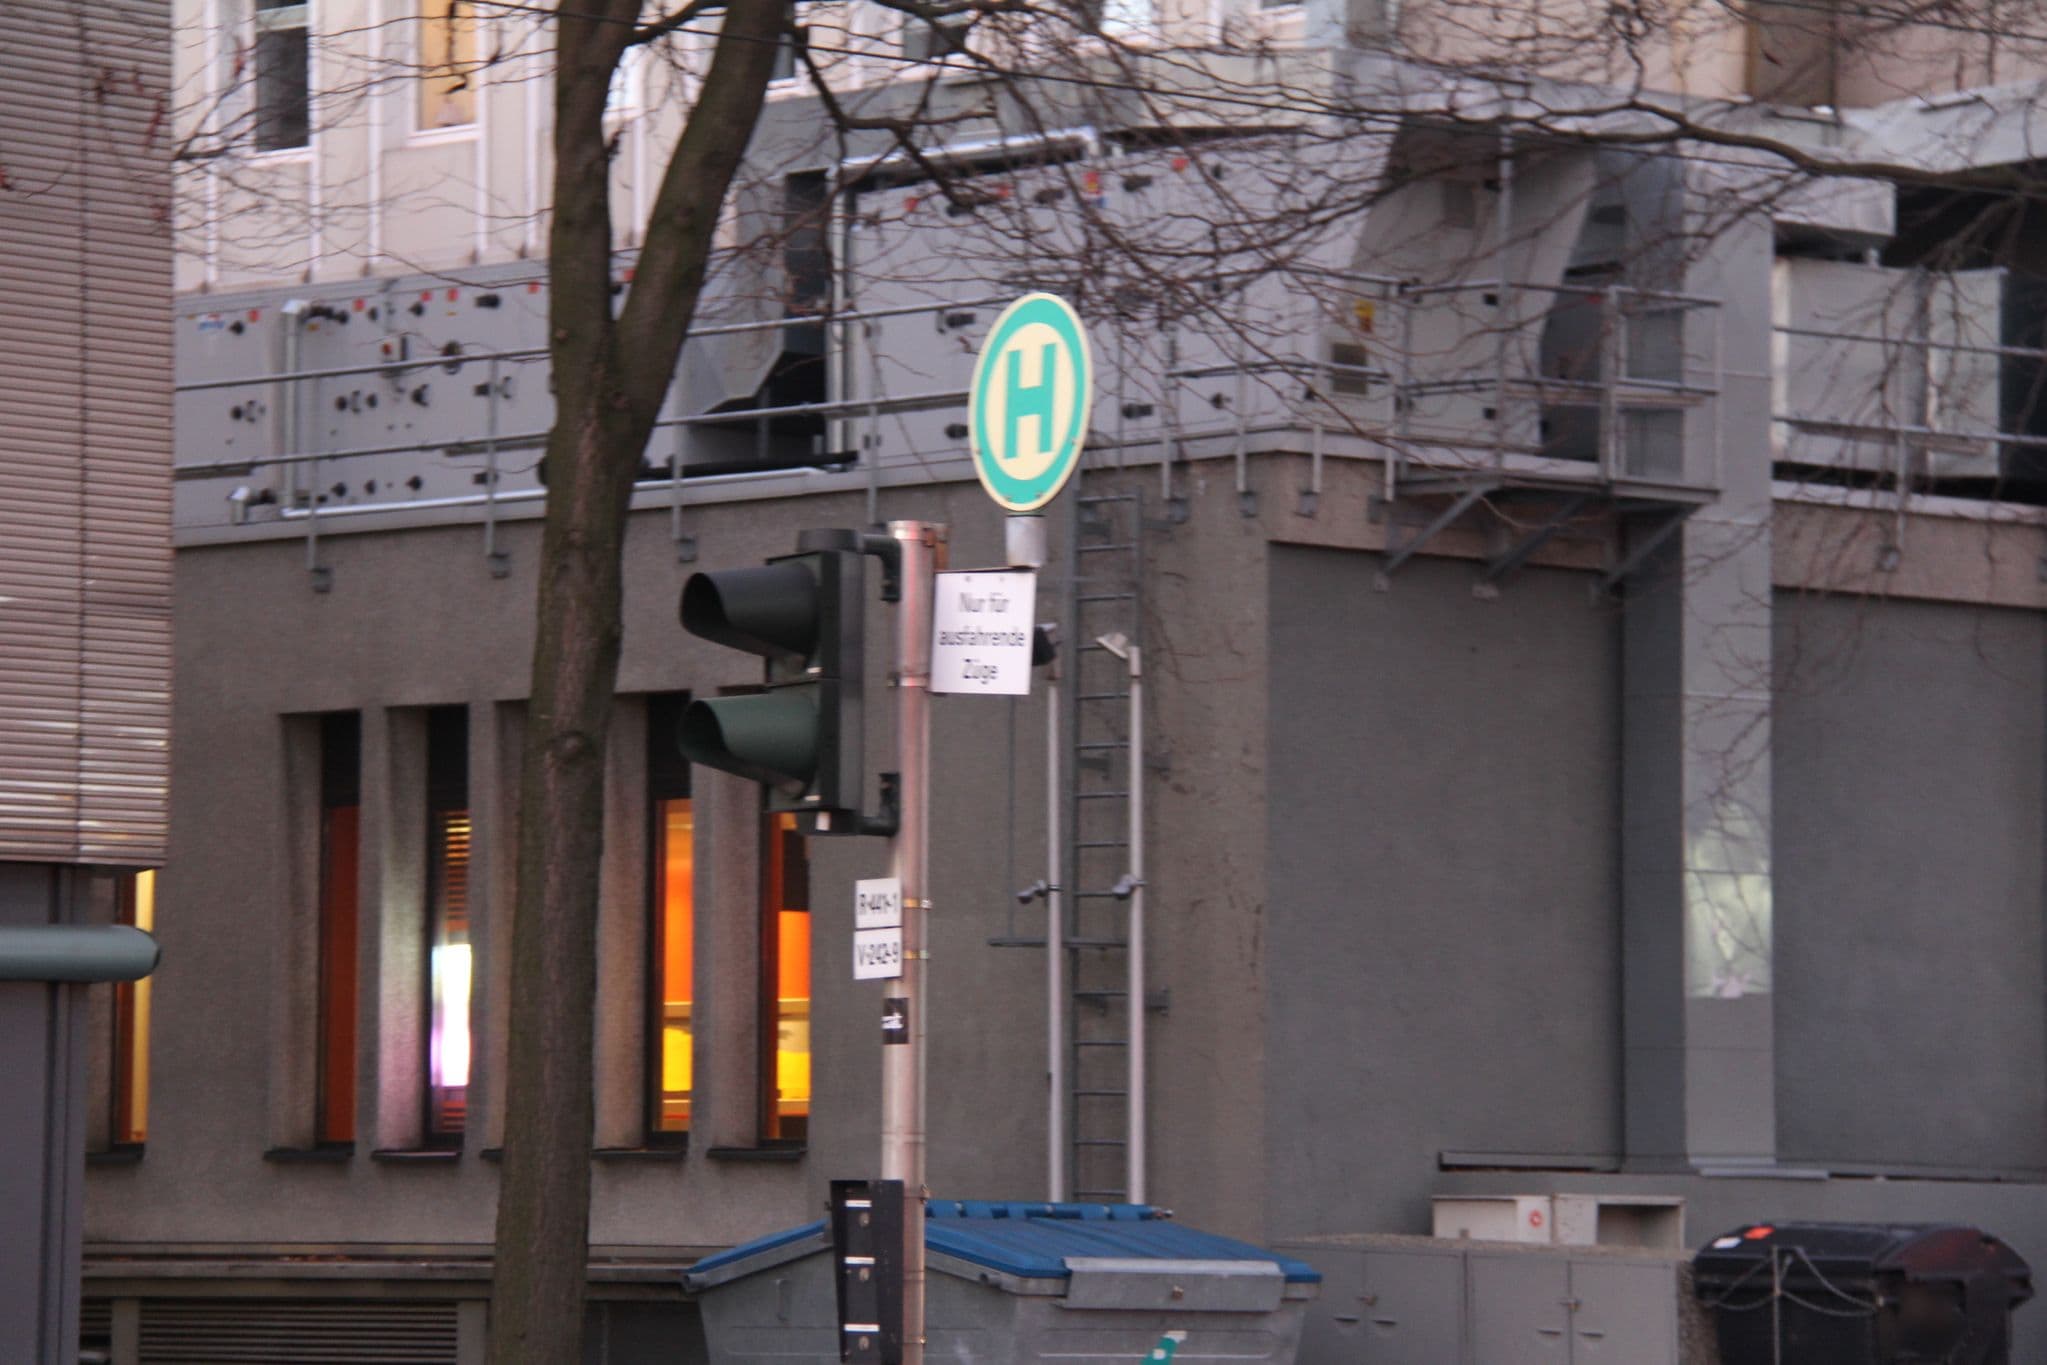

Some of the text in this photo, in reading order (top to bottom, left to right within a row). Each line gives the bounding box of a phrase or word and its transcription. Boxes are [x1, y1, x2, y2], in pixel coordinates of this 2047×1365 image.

[1003, 343, 1056, 459] H
[960, 592, 1009, 612] Nur für
[939, 626, 1025, 647] ausfahrende
[962, 658, 998, 685] Züge
